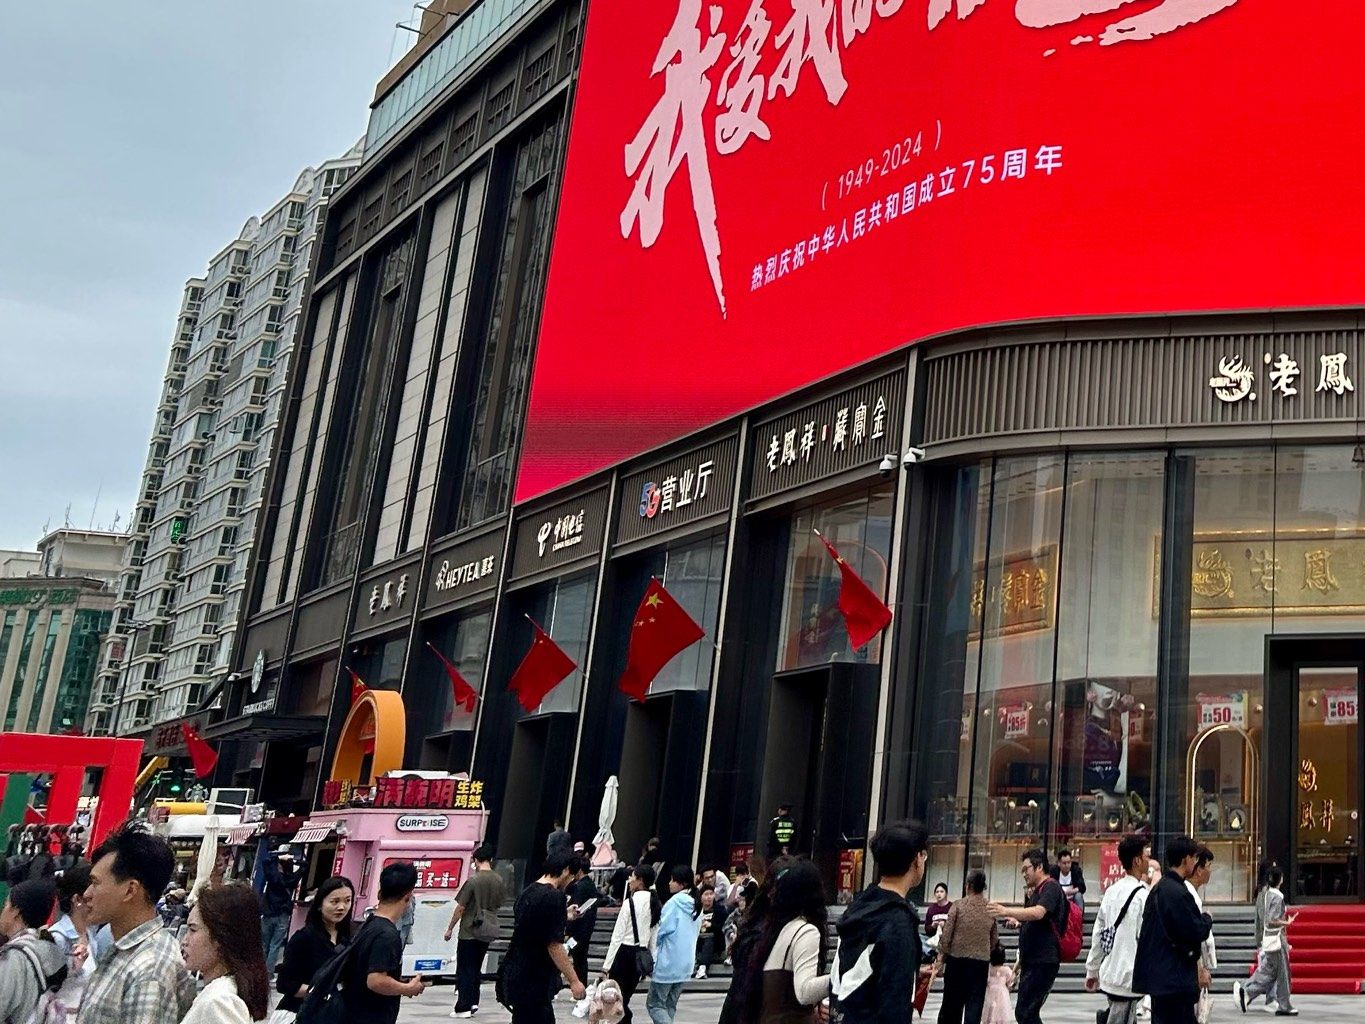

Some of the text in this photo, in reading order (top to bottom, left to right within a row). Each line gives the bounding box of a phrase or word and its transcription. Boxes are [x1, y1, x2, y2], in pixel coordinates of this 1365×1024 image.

[446, 562, 481, 589] HEYTEA
[456, 780, 484, 794] 生炸
[454, 794, 482, 808] 鸡架
